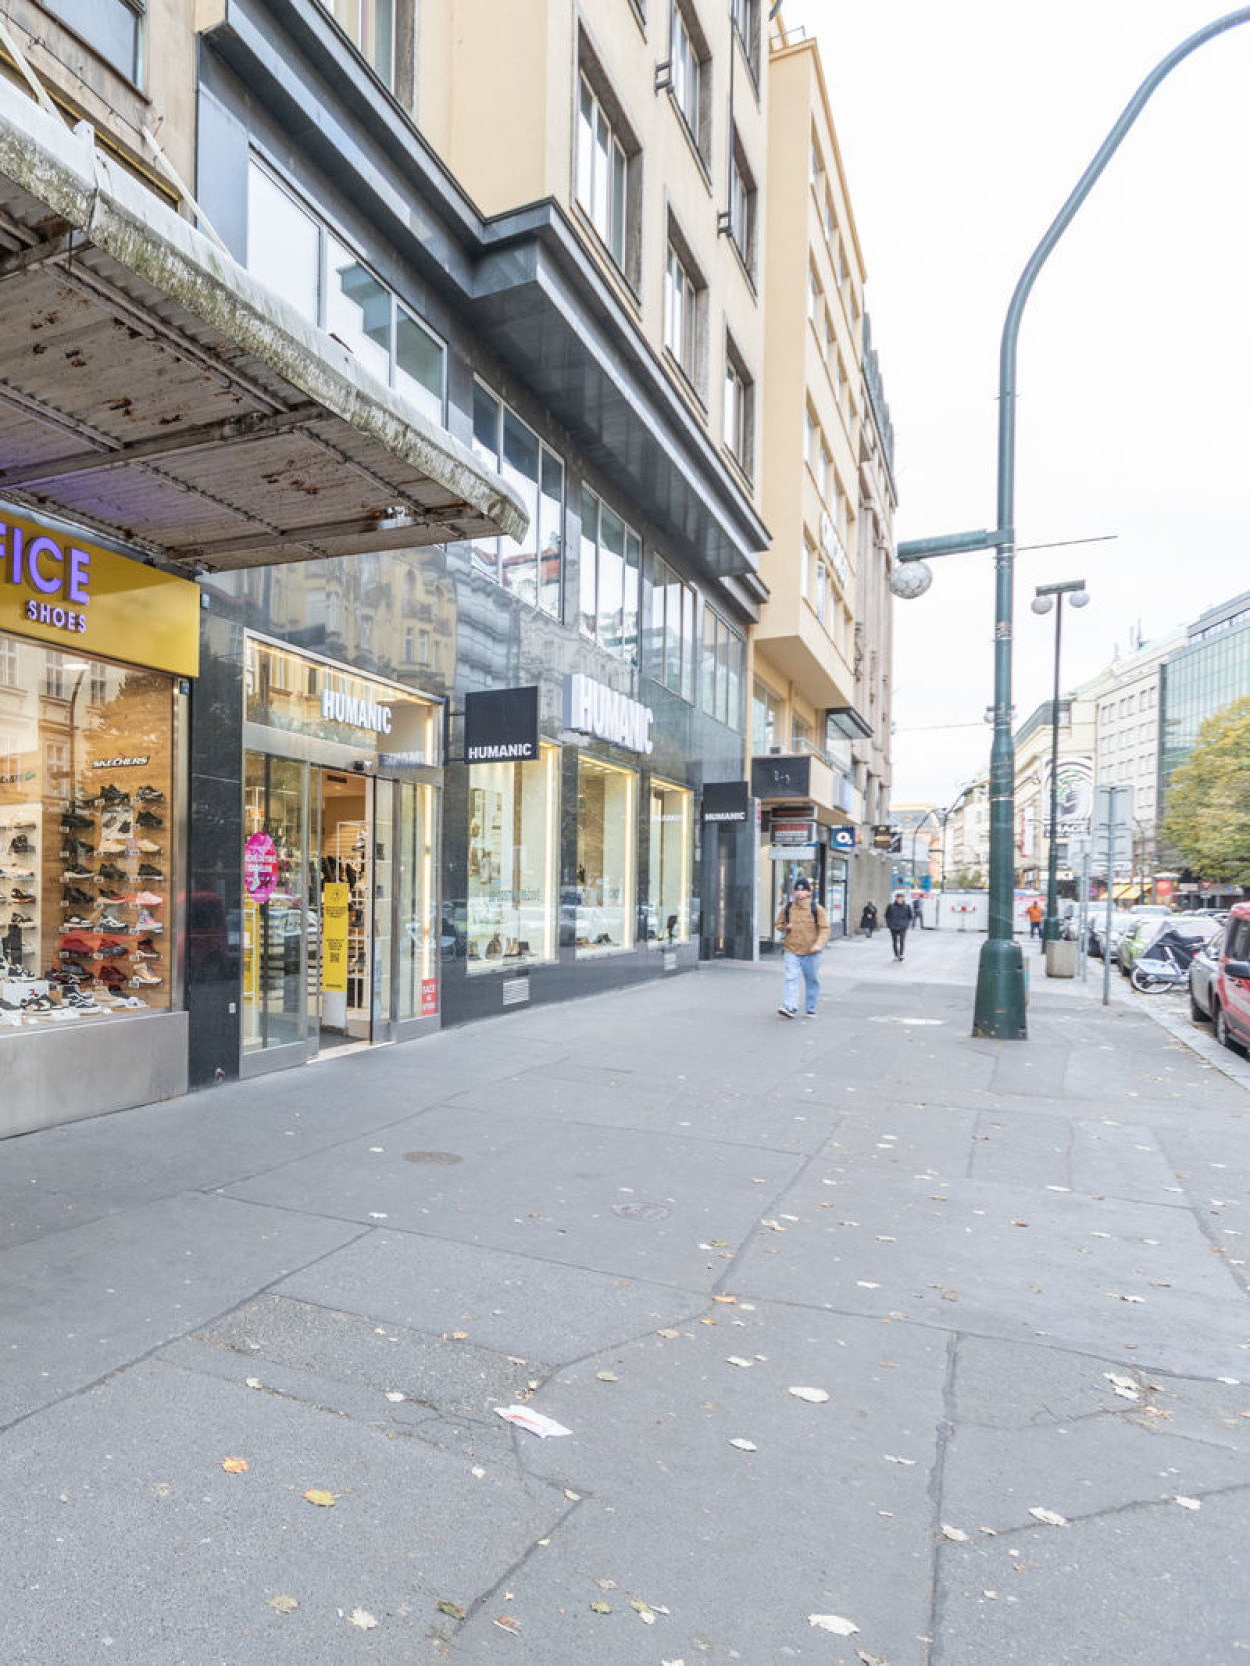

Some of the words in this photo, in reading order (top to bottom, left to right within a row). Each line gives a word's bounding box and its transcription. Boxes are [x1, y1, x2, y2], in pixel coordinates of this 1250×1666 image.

[26, 599, 88, 634] SHOES
[321, 688, 393, 734] HUMANIC
[468, 743, 533, 760] HUMANIC
[704, 811, 746, 822] HUMANIC
